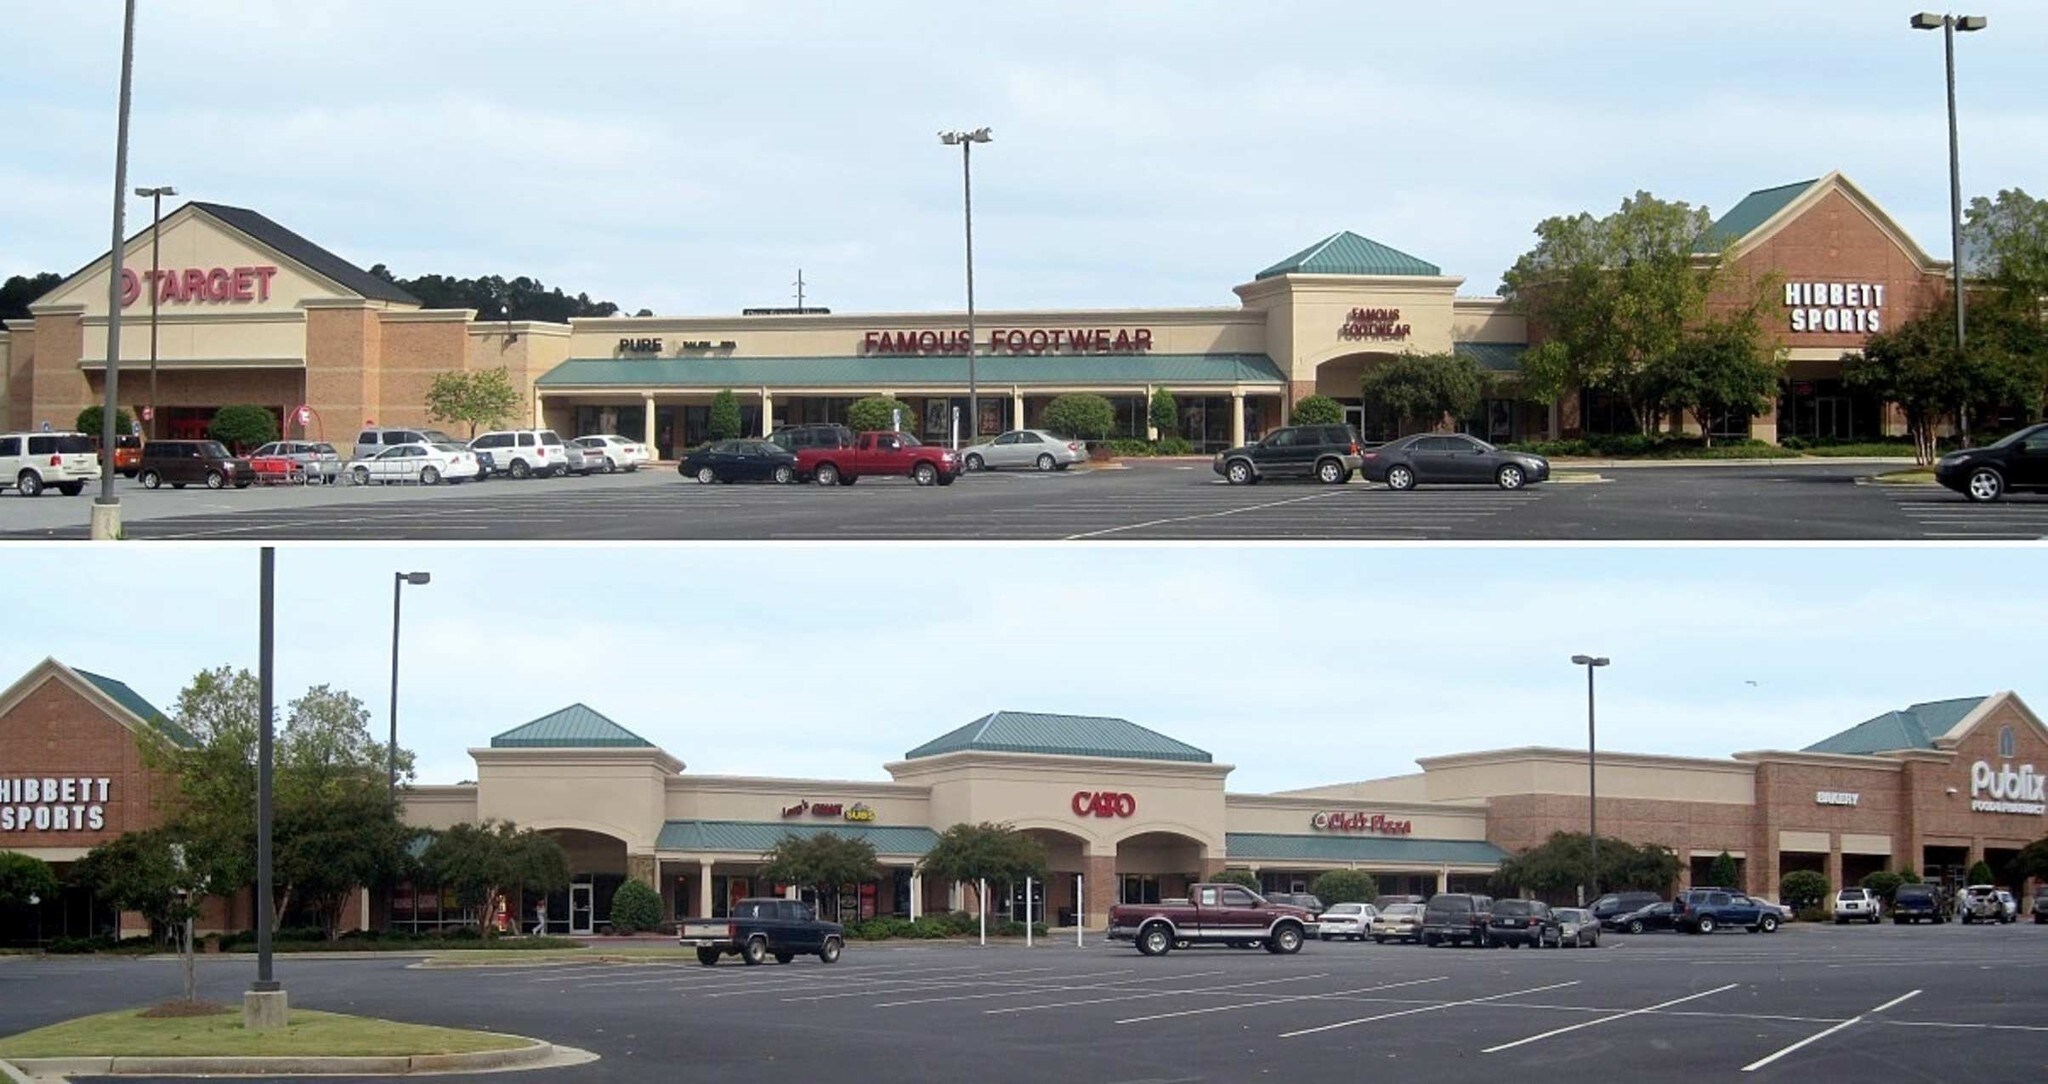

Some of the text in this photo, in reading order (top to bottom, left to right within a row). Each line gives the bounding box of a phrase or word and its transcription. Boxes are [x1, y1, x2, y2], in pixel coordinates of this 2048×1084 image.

[144, 266, 278, 303] TARGET
[1784, 282, 1883, 307] HIBBETT
[1351, 307, 1400, 321] FAMOUS
[1791, 308, 1880, 333] SPORTS
[864, 328, 1153, 352] FAMOUS FOOTWEAR
[1342, 323, 1411, 337] FOOTWEAR
[619, 338, 663, 352] PURE
[0, 778, 110, 803] HIBBETT
[1971, 760, 2046, 801] Publix
[1071, 791, 1136, 818] CATO
[1815, 791, 1859, 806] BAKERY
[1, 805, 104, 831] SPORTS
[845, 809, 876, 822] SUBS
